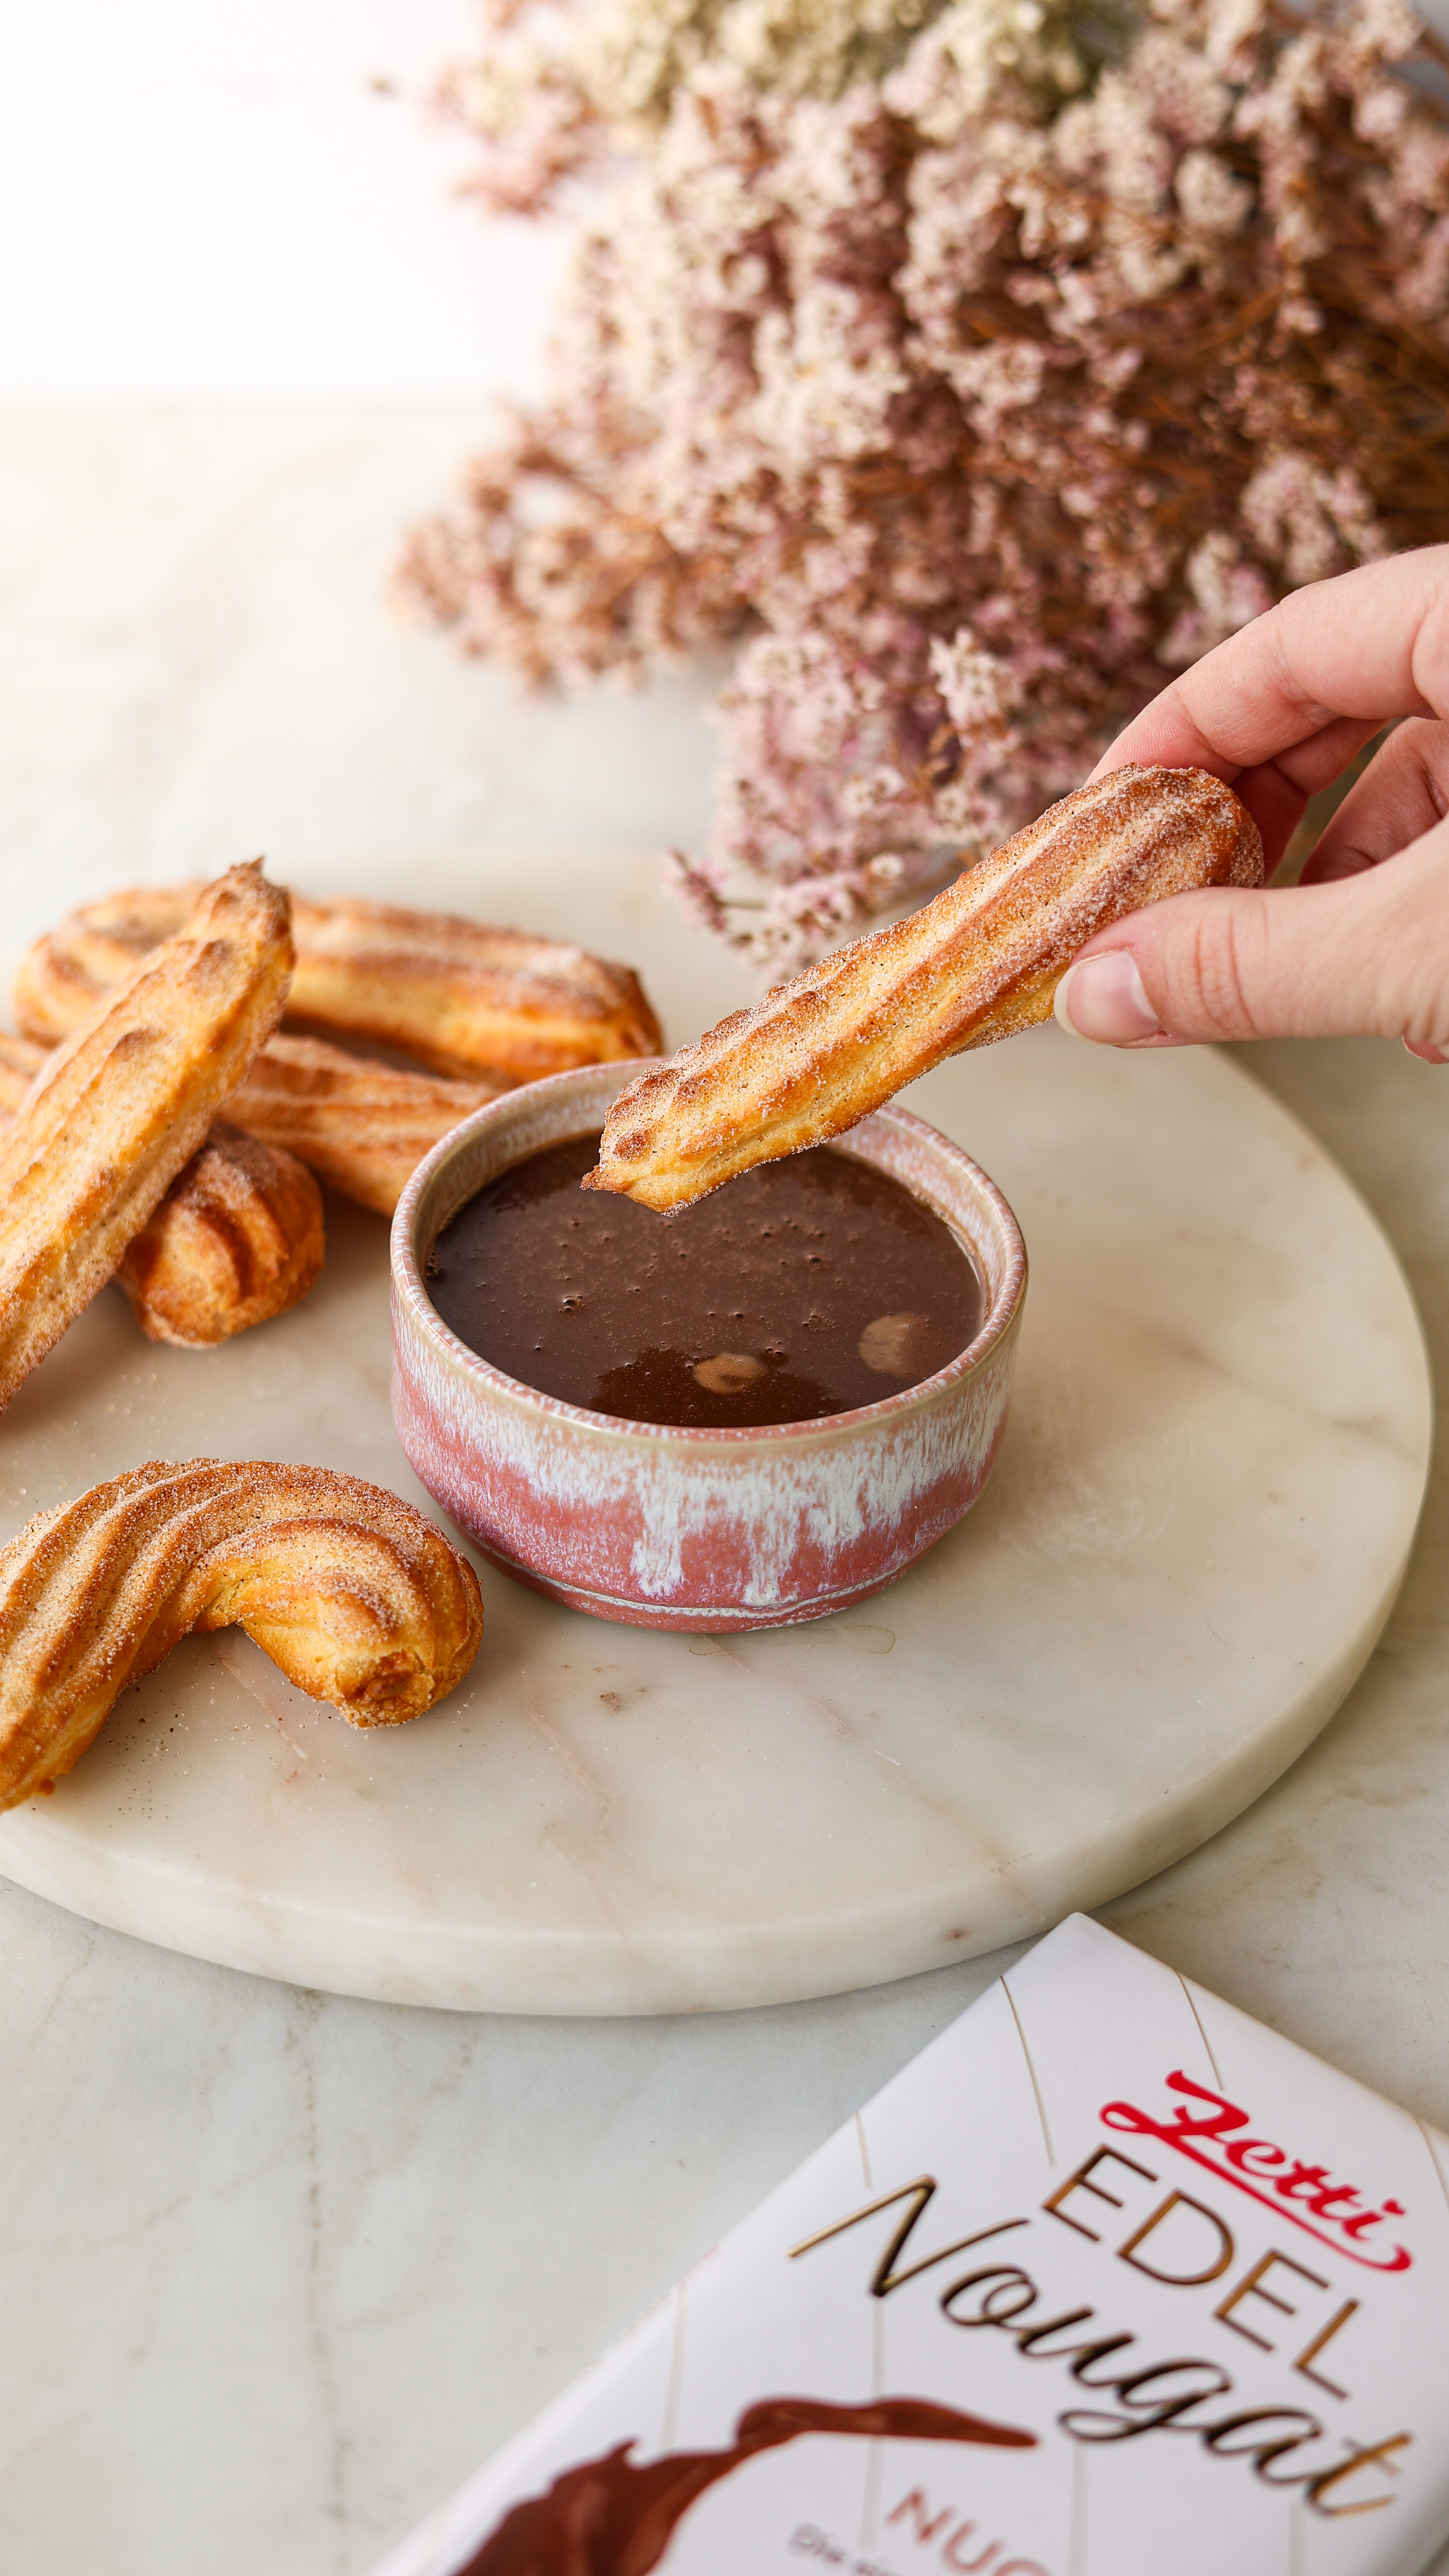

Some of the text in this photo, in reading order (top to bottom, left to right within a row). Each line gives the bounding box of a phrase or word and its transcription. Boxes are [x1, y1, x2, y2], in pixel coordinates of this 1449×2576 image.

[1042, 2144, 1360, 2400] EDEL
[1099, 2069, 1413, 2271] Zetti
[785, 2174, 1413, 2517] Nougat
